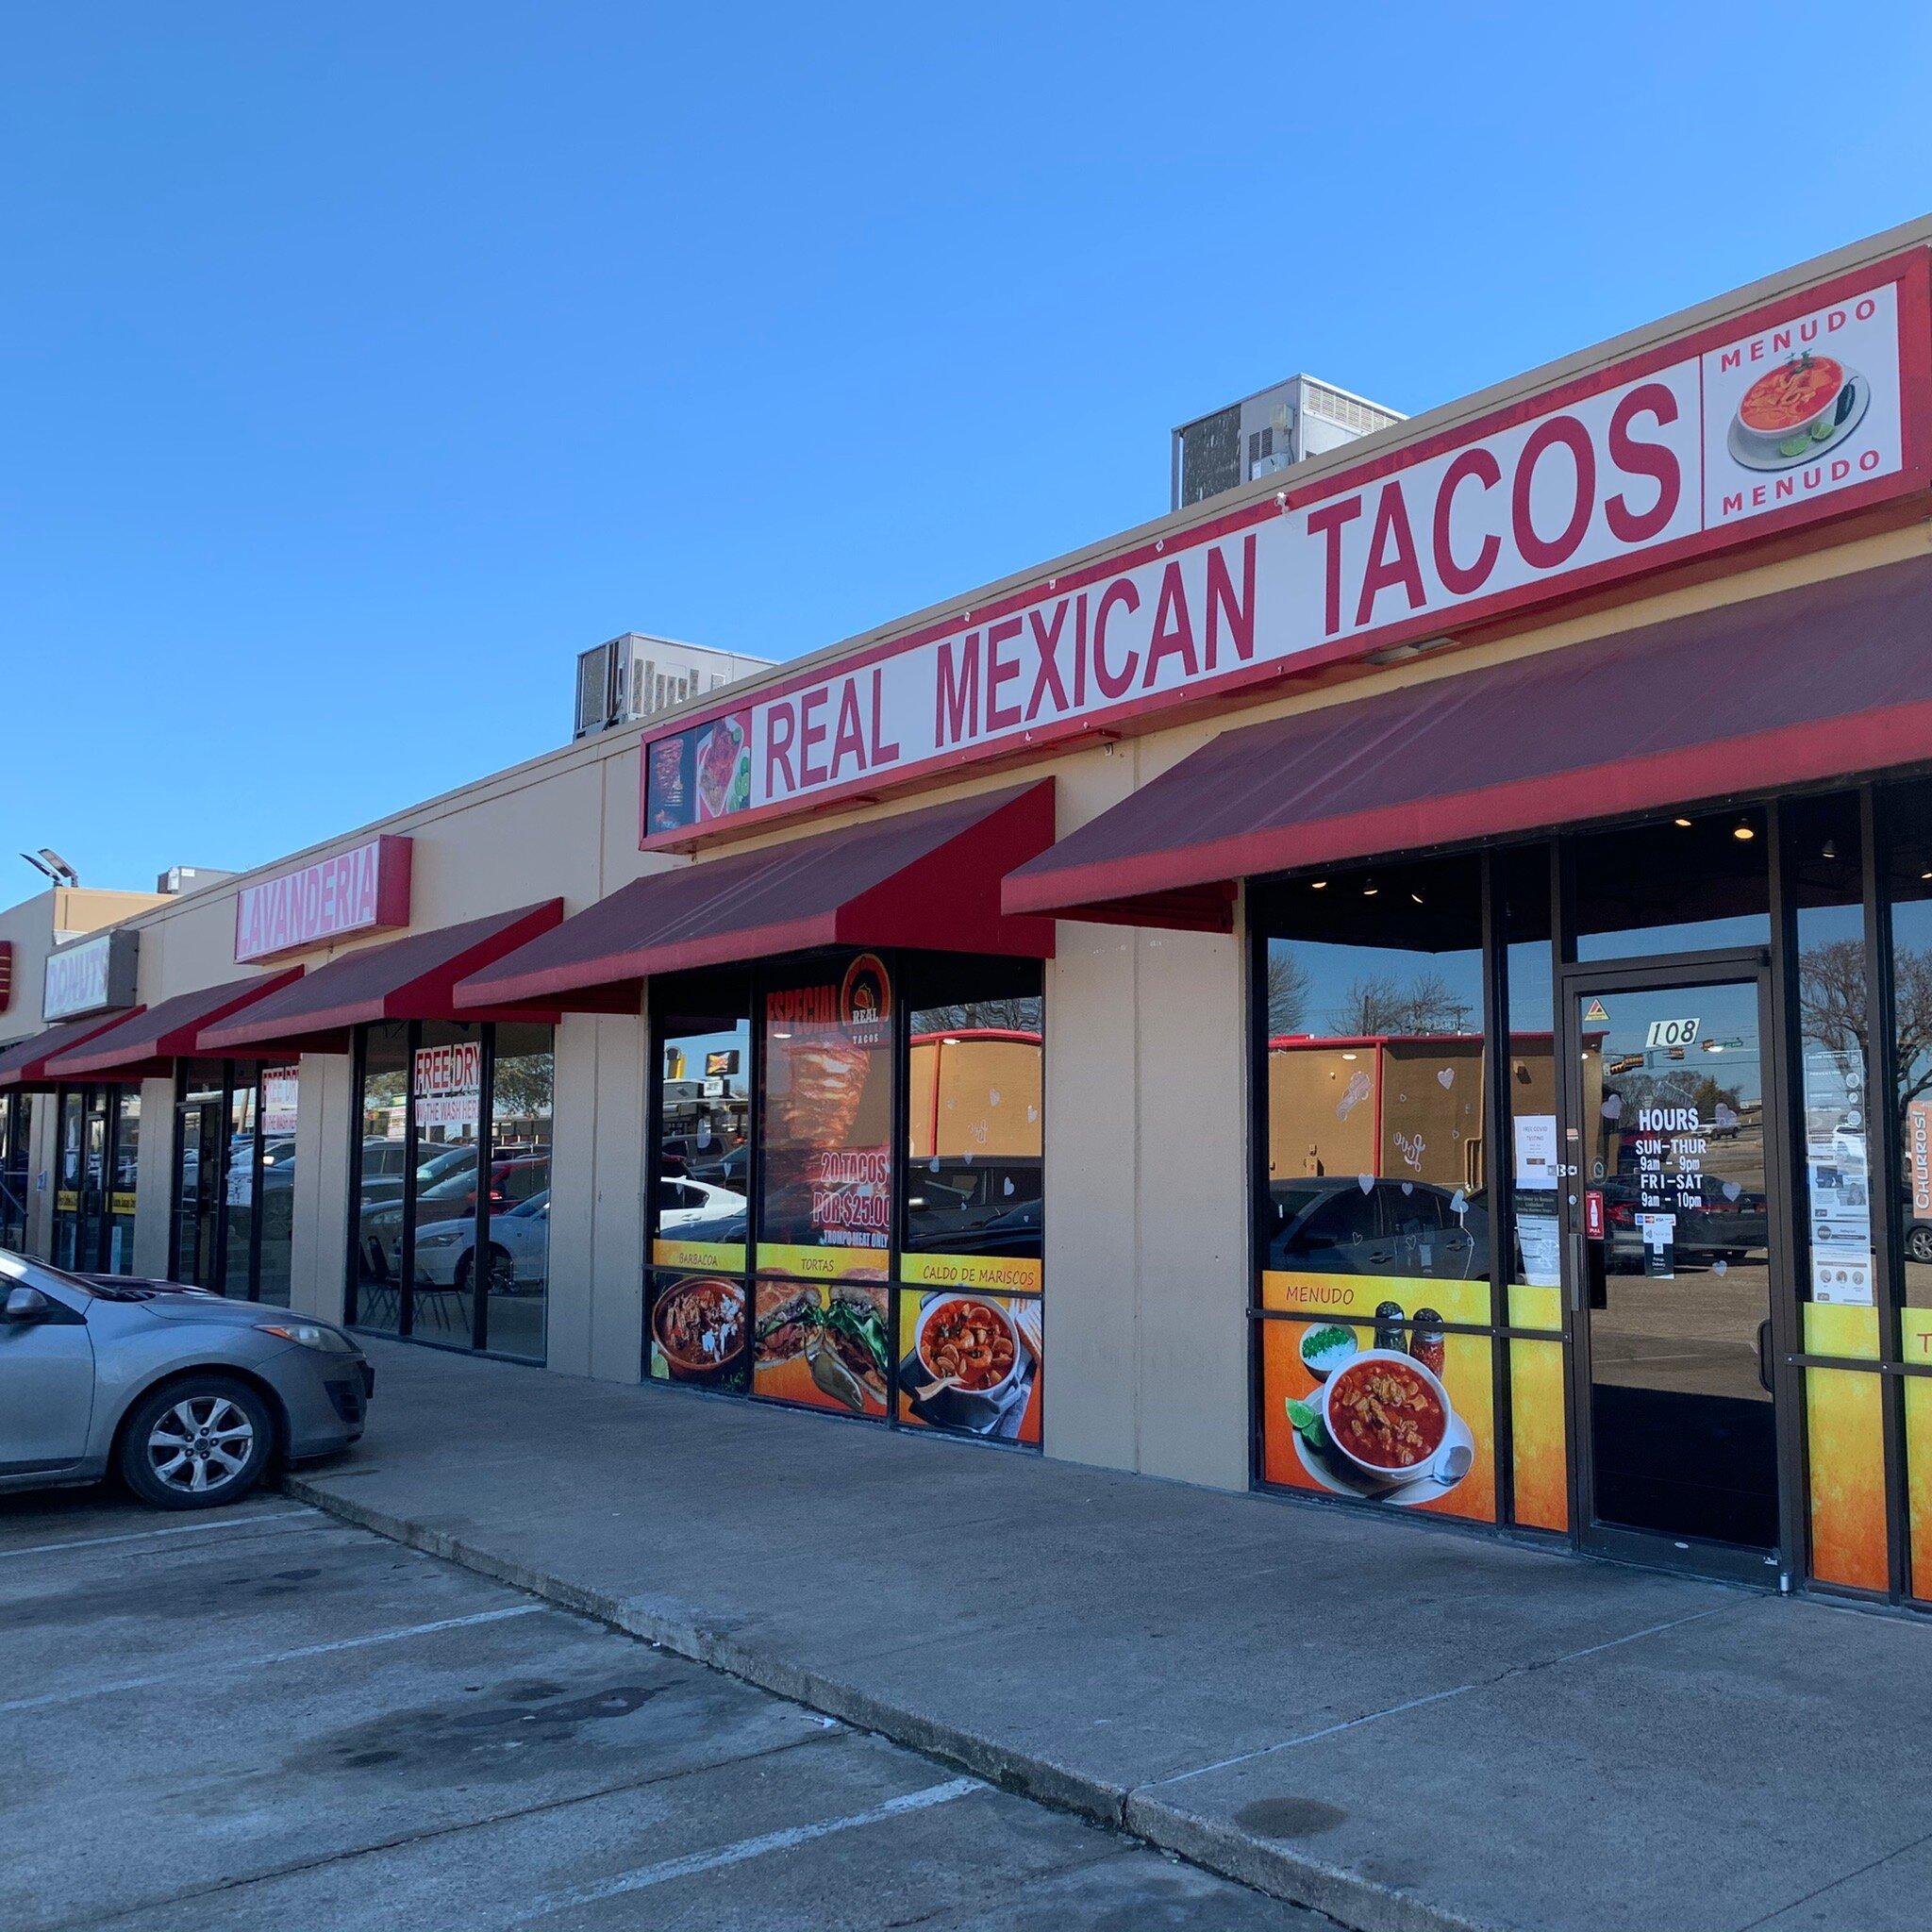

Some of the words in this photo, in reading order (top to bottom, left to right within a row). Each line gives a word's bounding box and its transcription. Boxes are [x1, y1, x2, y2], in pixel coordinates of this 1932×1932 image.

[1721, 299, 1875, 373] MENUDO
[1723, 450, 1880, 516] MENUDO
[765, 668, 900, 798] REAL
[935, 533, 1257, 749] MEXICAN
[1307, 383, 1681, 637] TACOS
[238, 845, 375, 955] LAVANDERIA
[766, 984, 838, 1035] ESPECIAL
[852, 1008, 879, 1025] REAL
[852, 1033, 879, 1045] TACOS
[1653, 1020, 1696, 1045] 108
[415, 1050, 450, 1091] FREE
[454, 1045, 480, 1087] DRY
[1639, 1108, 1699, 1131] HOURS
[1635, 1139, 1707, 1155] SUN-THUR
[821, 1153, 840, 1183] 20
[841, 1153, 887, 1186] TACOS
[1640, 1157, 1660, 1171] 9am
[1679, 1156, 1701, 1173] 9pm
[1912, 1109, 1930, 1210] CHURROS!
[1641, 1174, 1704, 1190] FRI-SAT
[812, 1191, 841, 1224] POR
[1641, 1191, 1660, 1207] 9am
[1676, 1192, 1703, 1209] 10pm
[851, 1232, 871, 1246] MEAT
[871, 1234, 889, 1248] ONLY
[678, 1252, 719, 1267] BARBACOA
[801, 1258, 835, 1272] TORTAS
[923, 1265, 958, 1280] CALDO
[961, 1268, 975, 1281] DE
[978, 1270, 1035, 1286] MARISCOS
[1286, 1286, 1355, 1305] MENUDO
